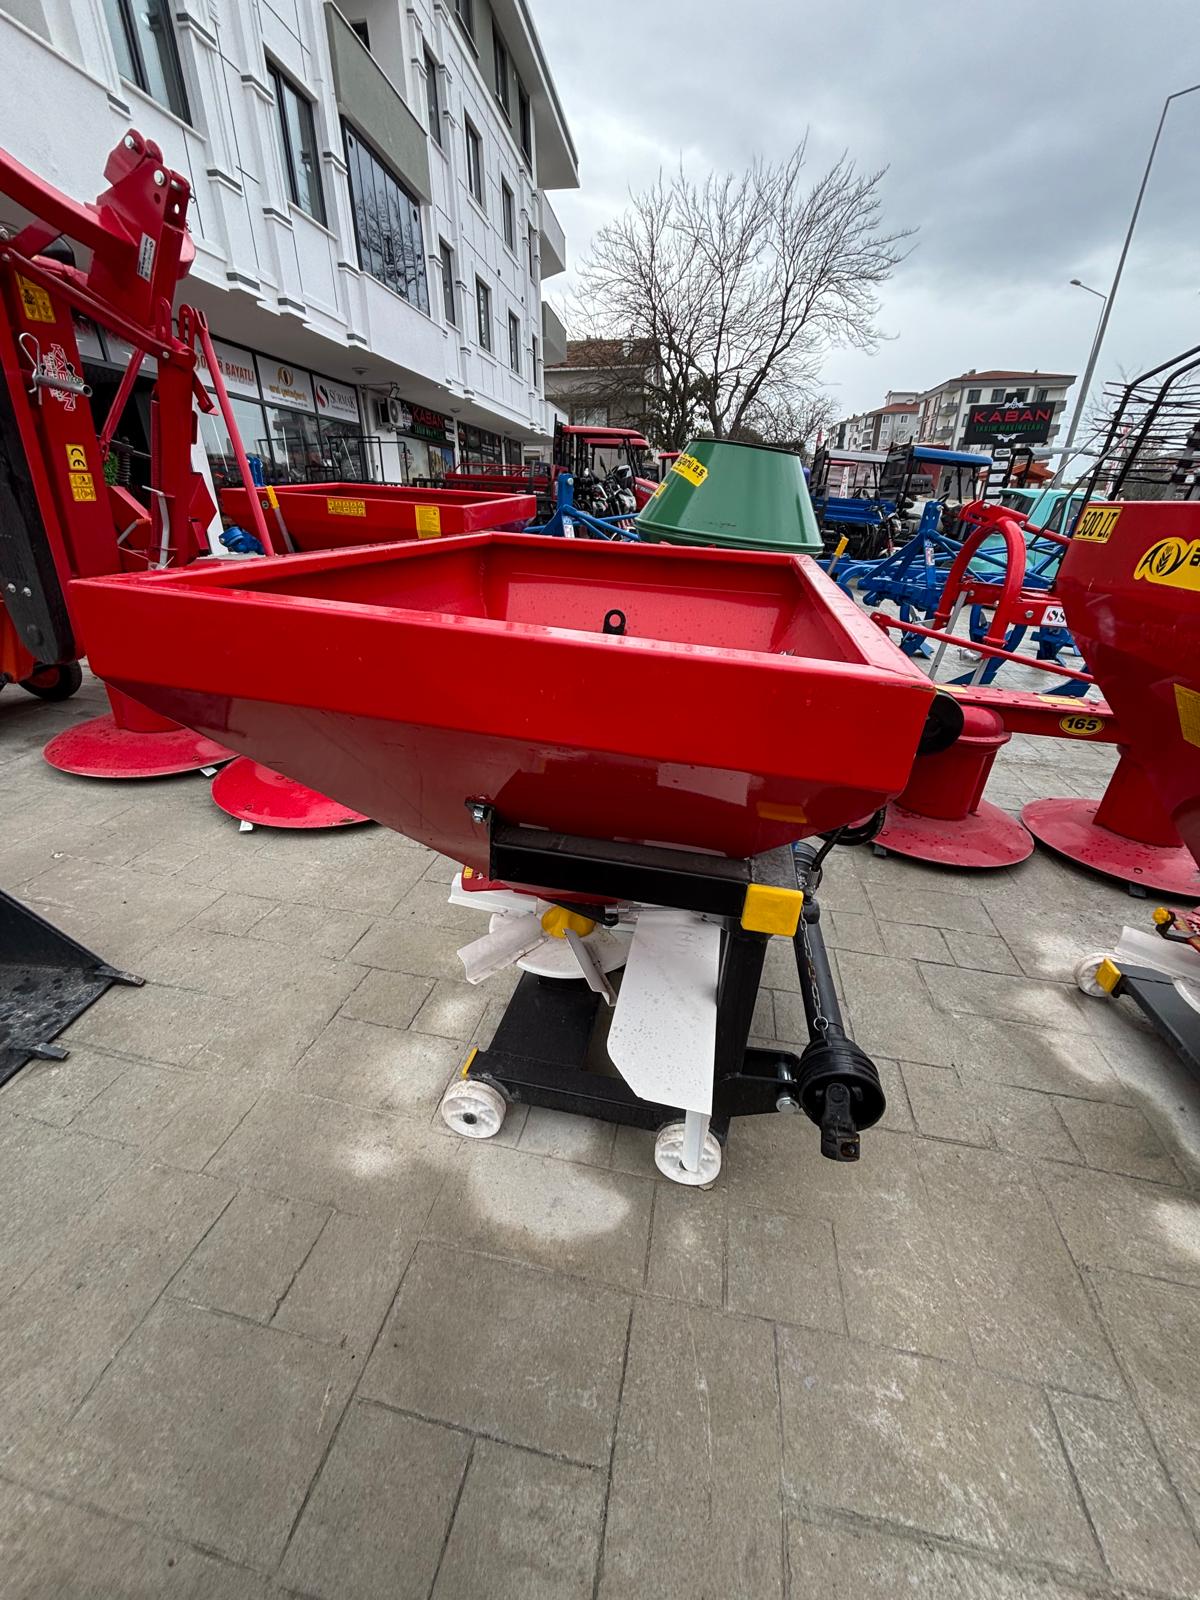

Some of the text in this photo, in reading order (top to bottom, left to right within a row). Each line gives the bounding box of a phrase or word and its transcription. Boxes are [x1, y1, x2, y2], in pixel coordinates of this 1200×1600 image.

[412, 405, 444, 429] KABAN
[973, 409, 1051, 423] KABAN
[1077, 511, 1103, 537] 500
[1067, 717, 1098, 731] 165
